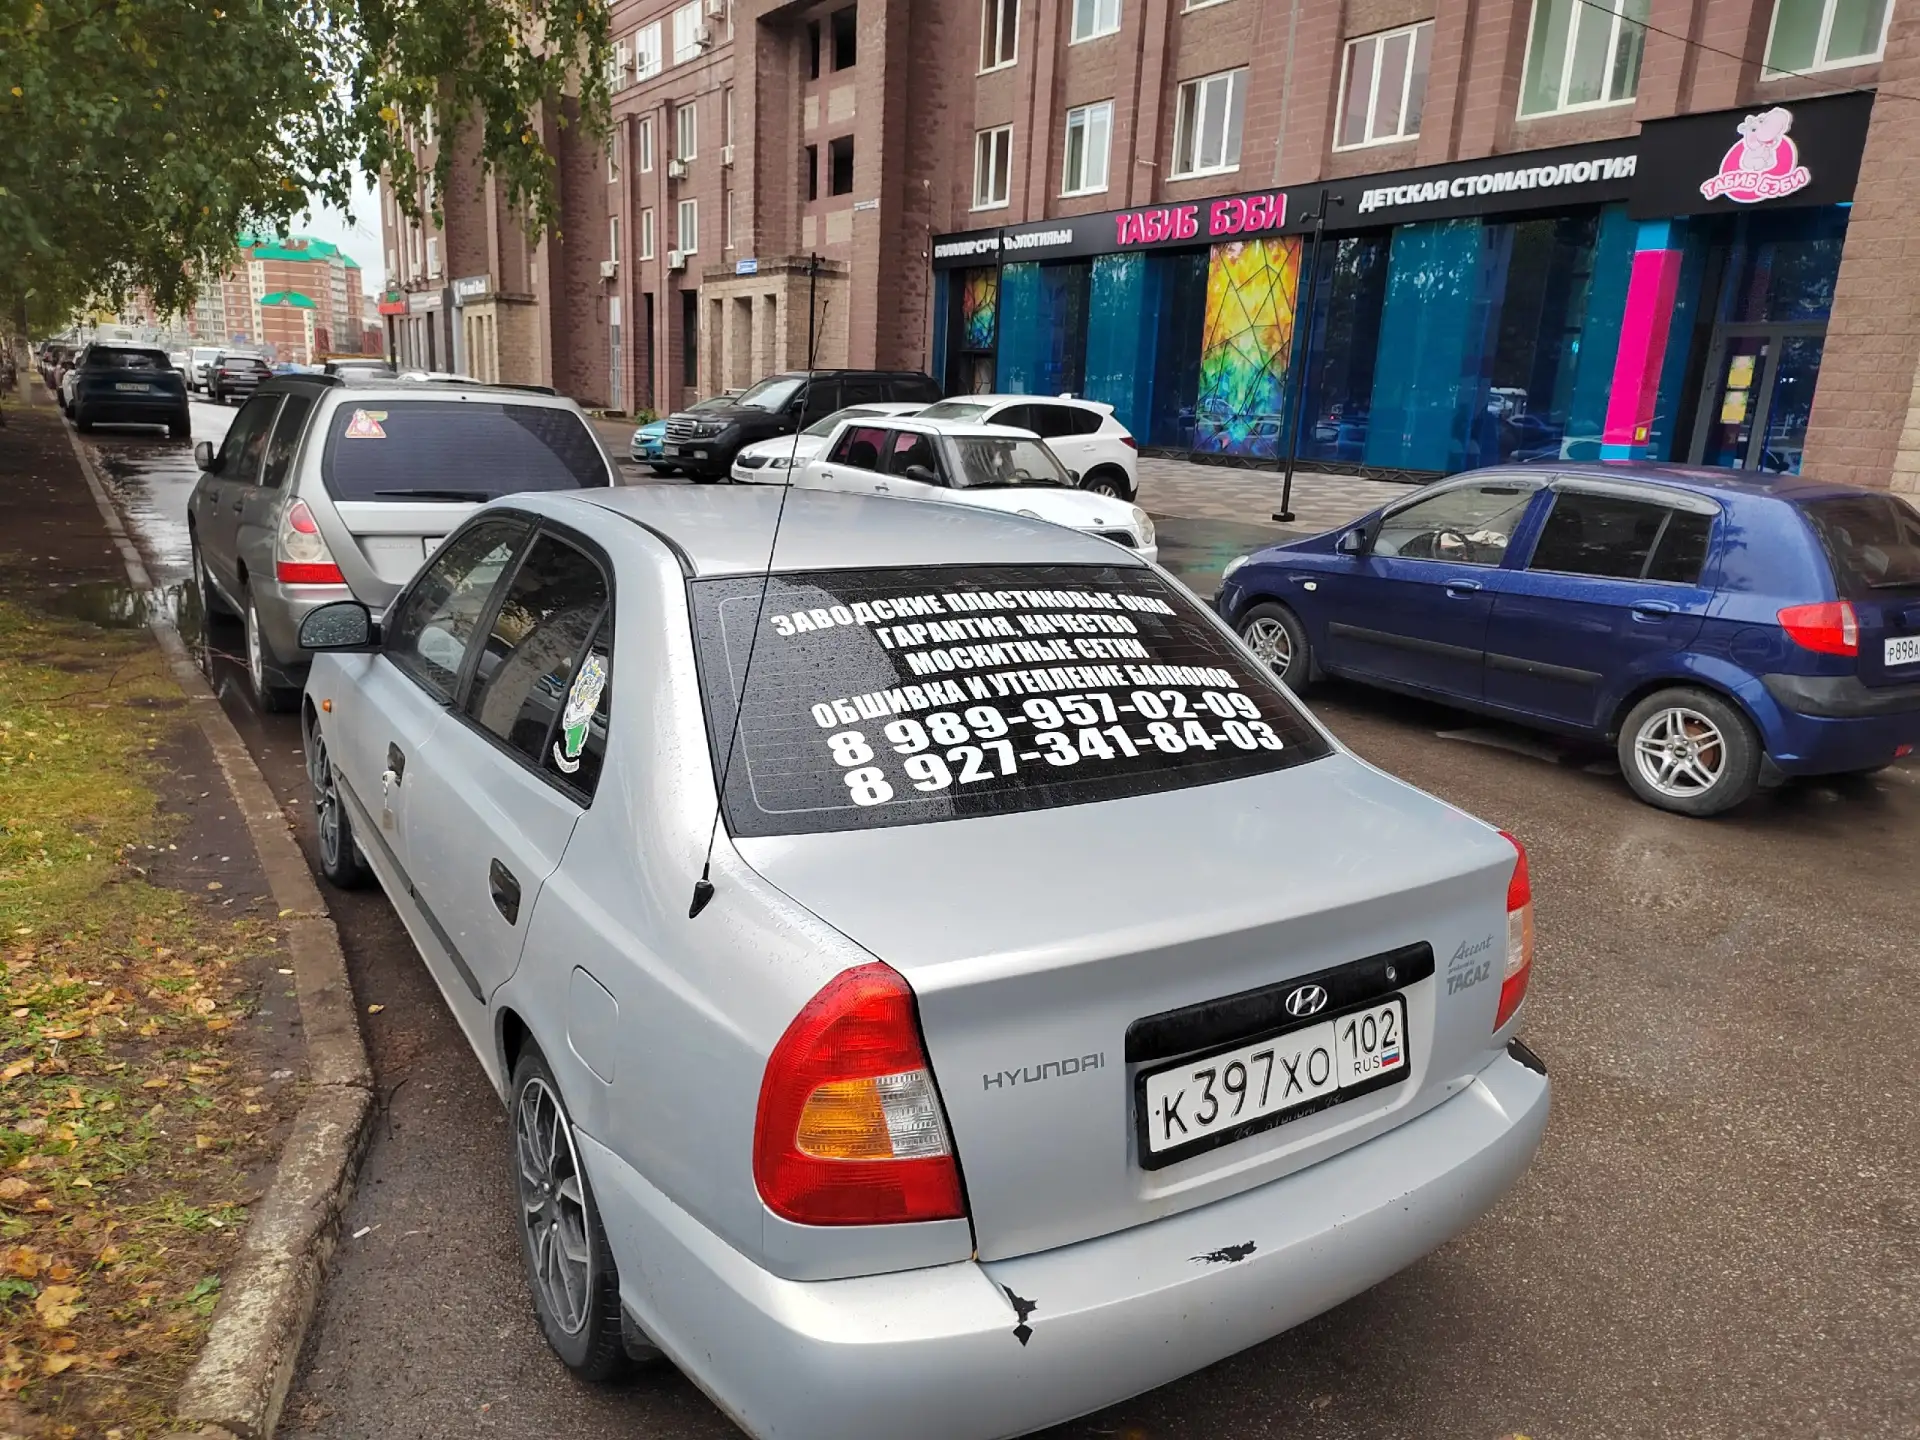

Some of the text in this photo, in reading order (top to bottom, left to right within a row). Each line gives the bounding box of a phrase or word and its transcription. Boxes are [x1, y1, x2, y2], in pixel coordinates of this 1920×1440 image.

[1358, 155, 1637, 213] ДЕТСКАЯ СТОМАТОЛОГИЯ
[1703, 168, 1806, 197] ТАБИБ БЭБИ
[1115, 193, 1288, 244] ТАБИБ БЭБИ
[770, 590, 1177, 636] ЗАВОДСКИЕ ПЛАСТИКОВЫЕ ОКНА
[875, 614, 1138, 649] ГАРАНТИЯ, КАЧЕСТВО
[904, 638, 1150, 676] МОСКИТНЫЕ СЕТКИ
[811, 664, 1240, 729] ОБШИВКА И УТЕПЛЕНИЕ БАЛКОНОВ
[827, 690, 1263, 768] 8 989-957-02-09
[843, 720, 1284, 807] 8 927-341-84-03
[1448, 933, 1494, 967] Accent
[1446, 960, 1491, 995] TAGAZ
[1342, 1007, 1397, 1060] 102
[982, 1051, 1106, 1090] HYUNDAI
[1353, 1055, 1380, 1077] RUS
